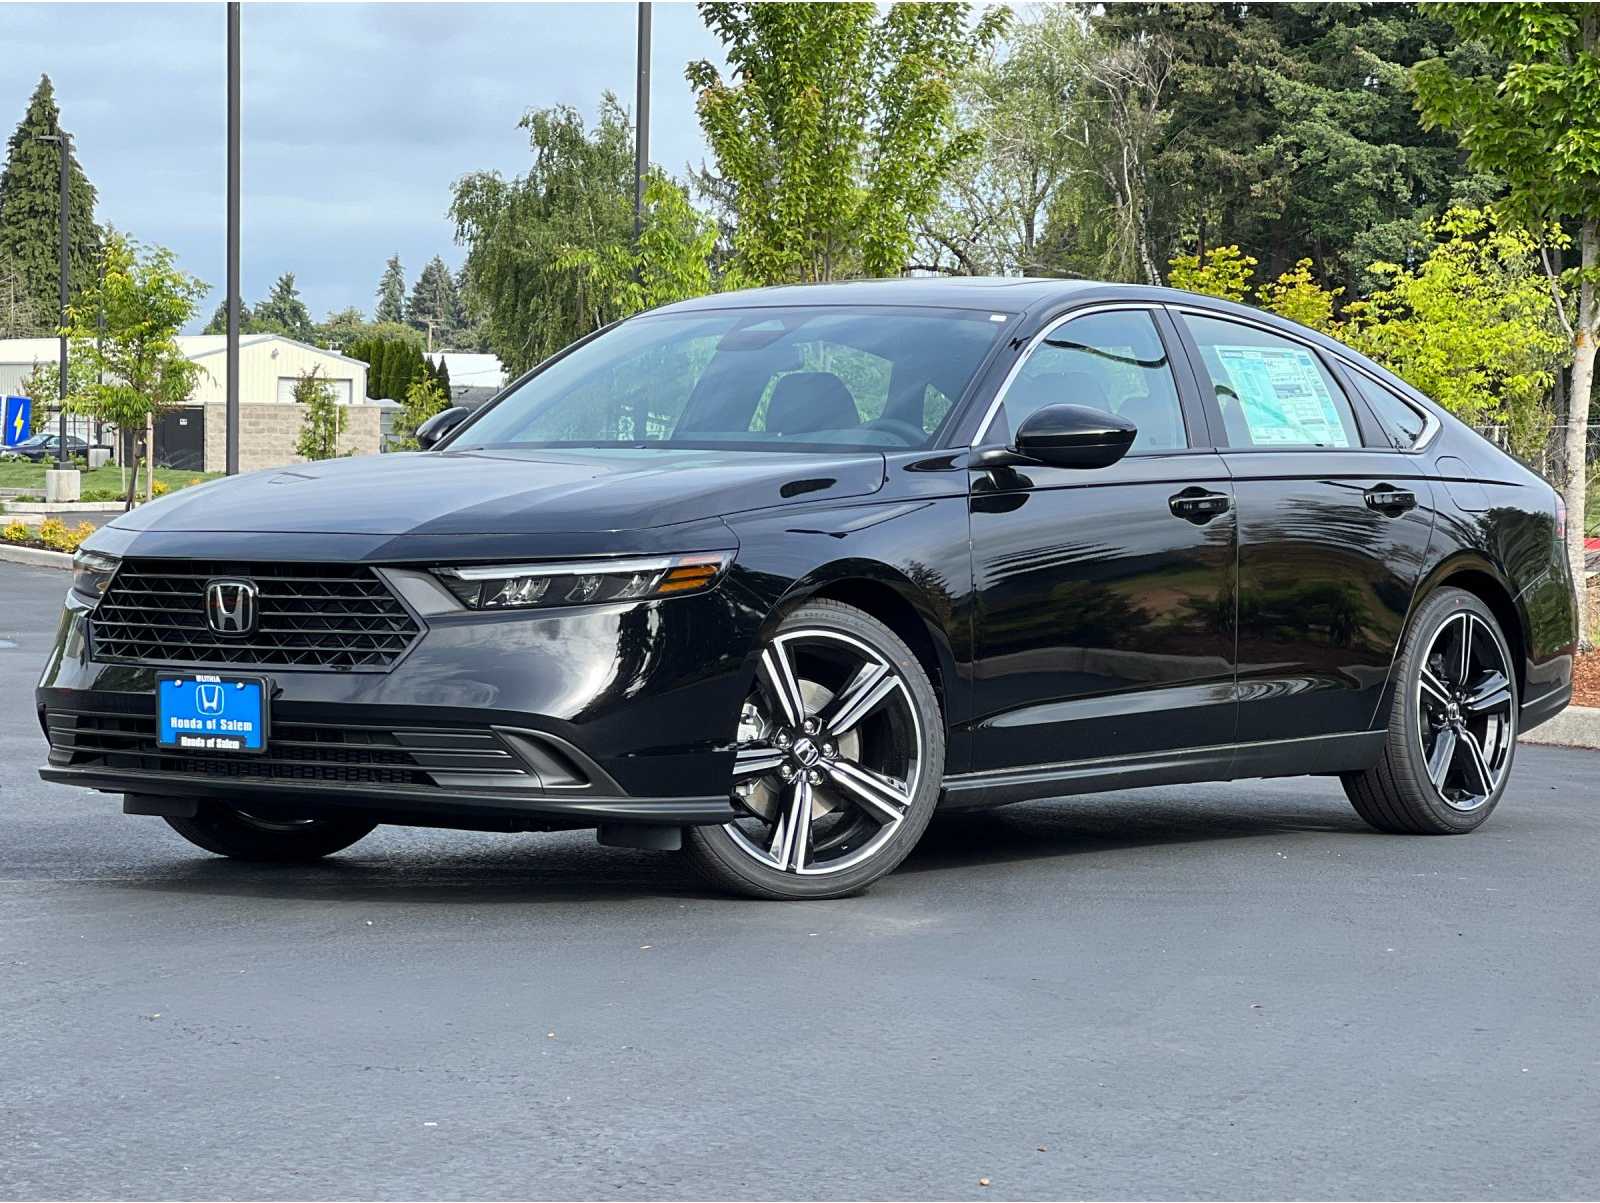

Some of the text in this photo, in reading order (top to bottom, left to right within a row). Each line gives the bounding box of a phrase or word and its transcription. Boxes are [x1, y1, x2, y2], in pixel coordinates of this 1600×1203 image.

[170, 716, 253, 732] Honda of Salem
[181, 736, 240, 750] Honda of Salem
